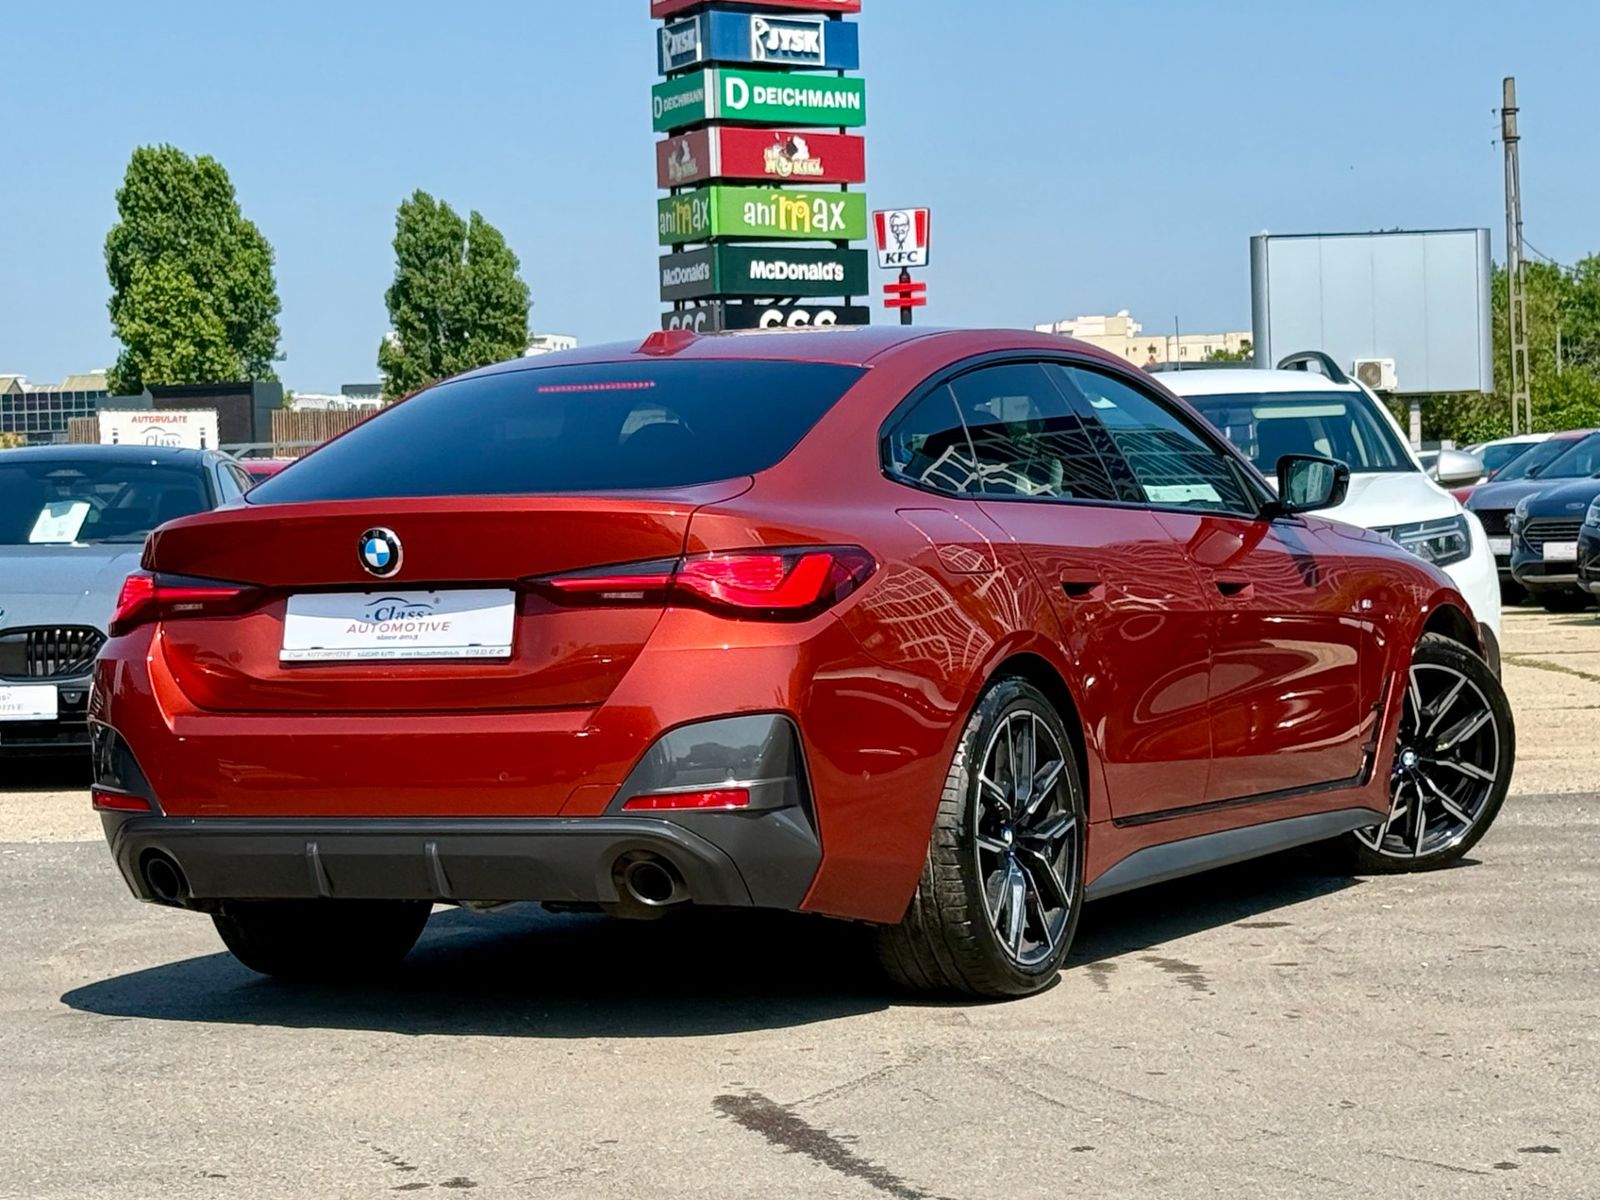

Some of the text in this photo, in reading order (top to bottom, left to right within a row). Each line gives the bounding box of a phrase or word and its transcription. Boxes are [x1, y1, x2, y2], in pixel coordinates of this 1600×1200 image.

[671, 28, 696, 56] JYSK
[766, 27, 821, 54] JYSK
[664, 87, 704, 112] DEICHMANN
[725, 77, 861, 110] D DEICHMANN
[885, 250, 918, 264] KFC
[663, 261, 710, 286] McDonald's
[750, 260, 845, 281] McDonald's
[374, 606, 425, 622] Class
[346, 621, 452, 634] AUTOMOTIVE
